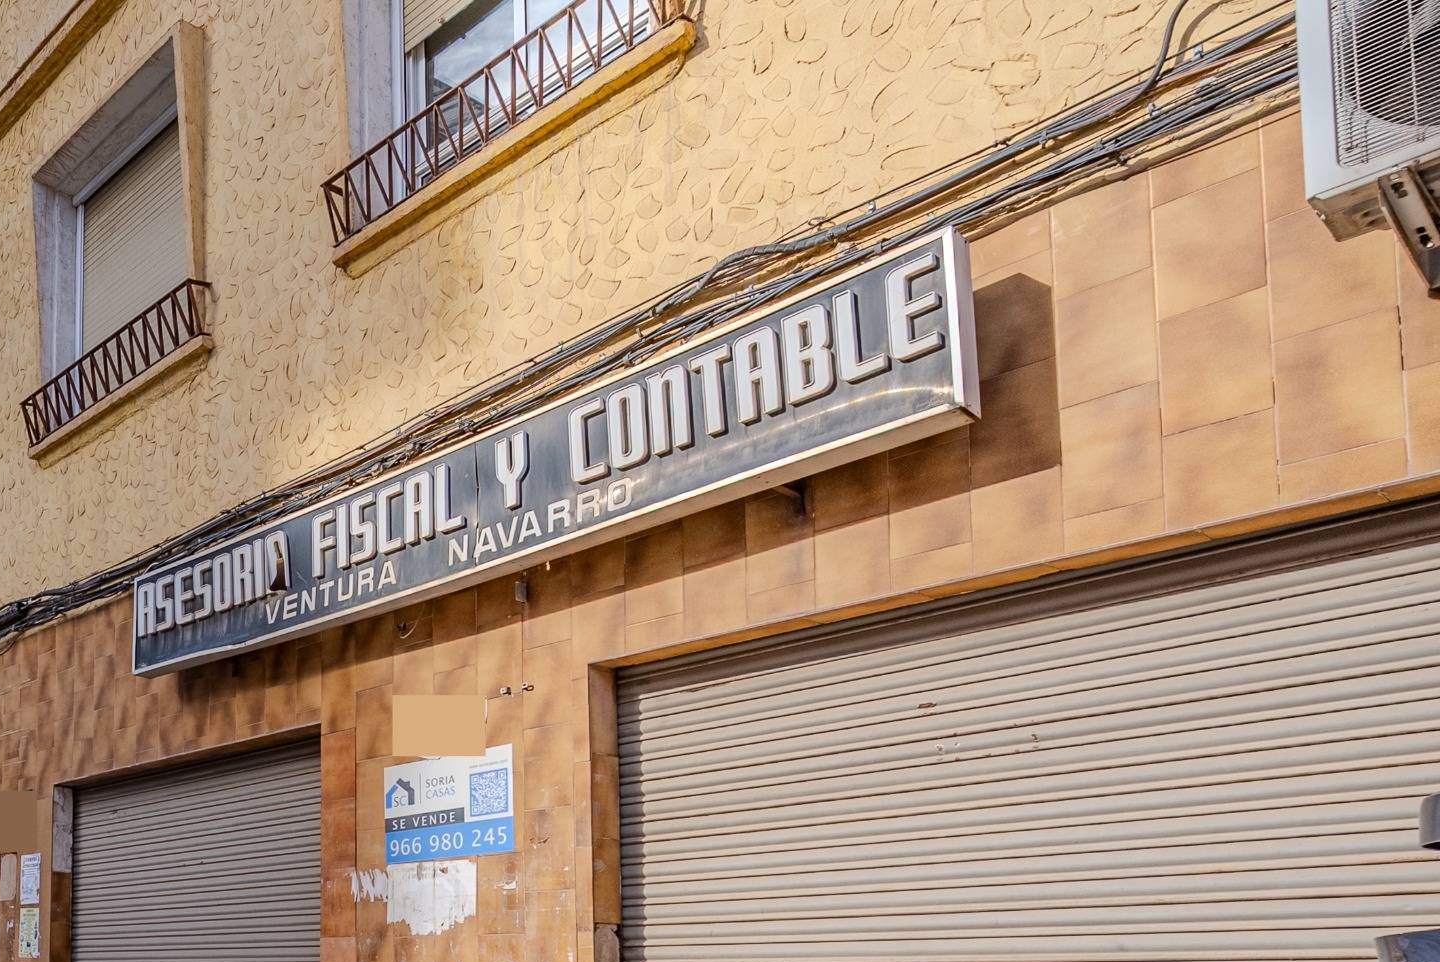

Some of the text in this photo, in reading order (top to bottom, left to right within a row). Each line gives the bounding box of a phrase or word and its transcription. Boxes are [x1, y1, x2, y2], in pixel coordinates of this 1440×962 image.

[137, 252, 944, 638] ASESORIA FISCAL Y CONTABLE
[265, 477, 633, 625] VENTURA NAVARRO
[425, 775, 456, 788] SORIA
[425, 786, 456, 800] CASAS
[392, 811, 457, 831] SE VENDE
[390, 826, 508, 857] 966 980 245
